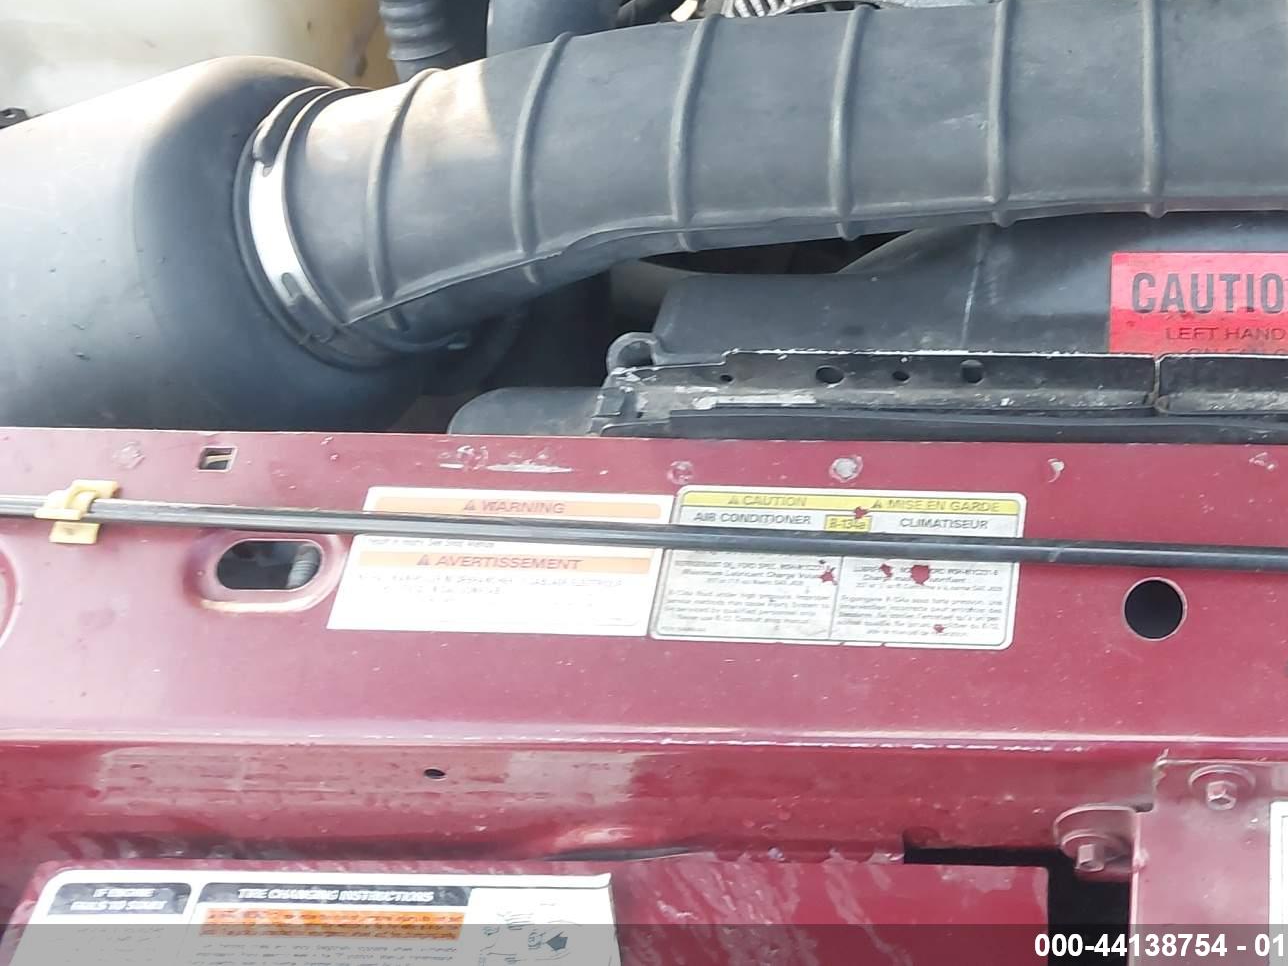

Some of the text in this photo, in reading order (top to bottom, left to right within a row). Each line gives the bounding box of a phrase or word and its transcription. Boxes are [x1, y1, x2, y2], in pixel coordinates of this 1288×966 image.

[1165, 327, 1219, 340] LEFT
[1224, 327, 1287, 341] HAND
[481, 500, 567, 514] WARNING
[743, 495, 807, 507] CAUTION
[888, 499, 1001, 512] MISE EN GARDE
[694, 512, 812, 525] AIR CONDITIONER
[900, 518, 988, 529] CLIMATISEUR
[435, 555, 585, 569] AVERTISSEMENT
[339, 890, 434, 902] INSTRUCTIONS
